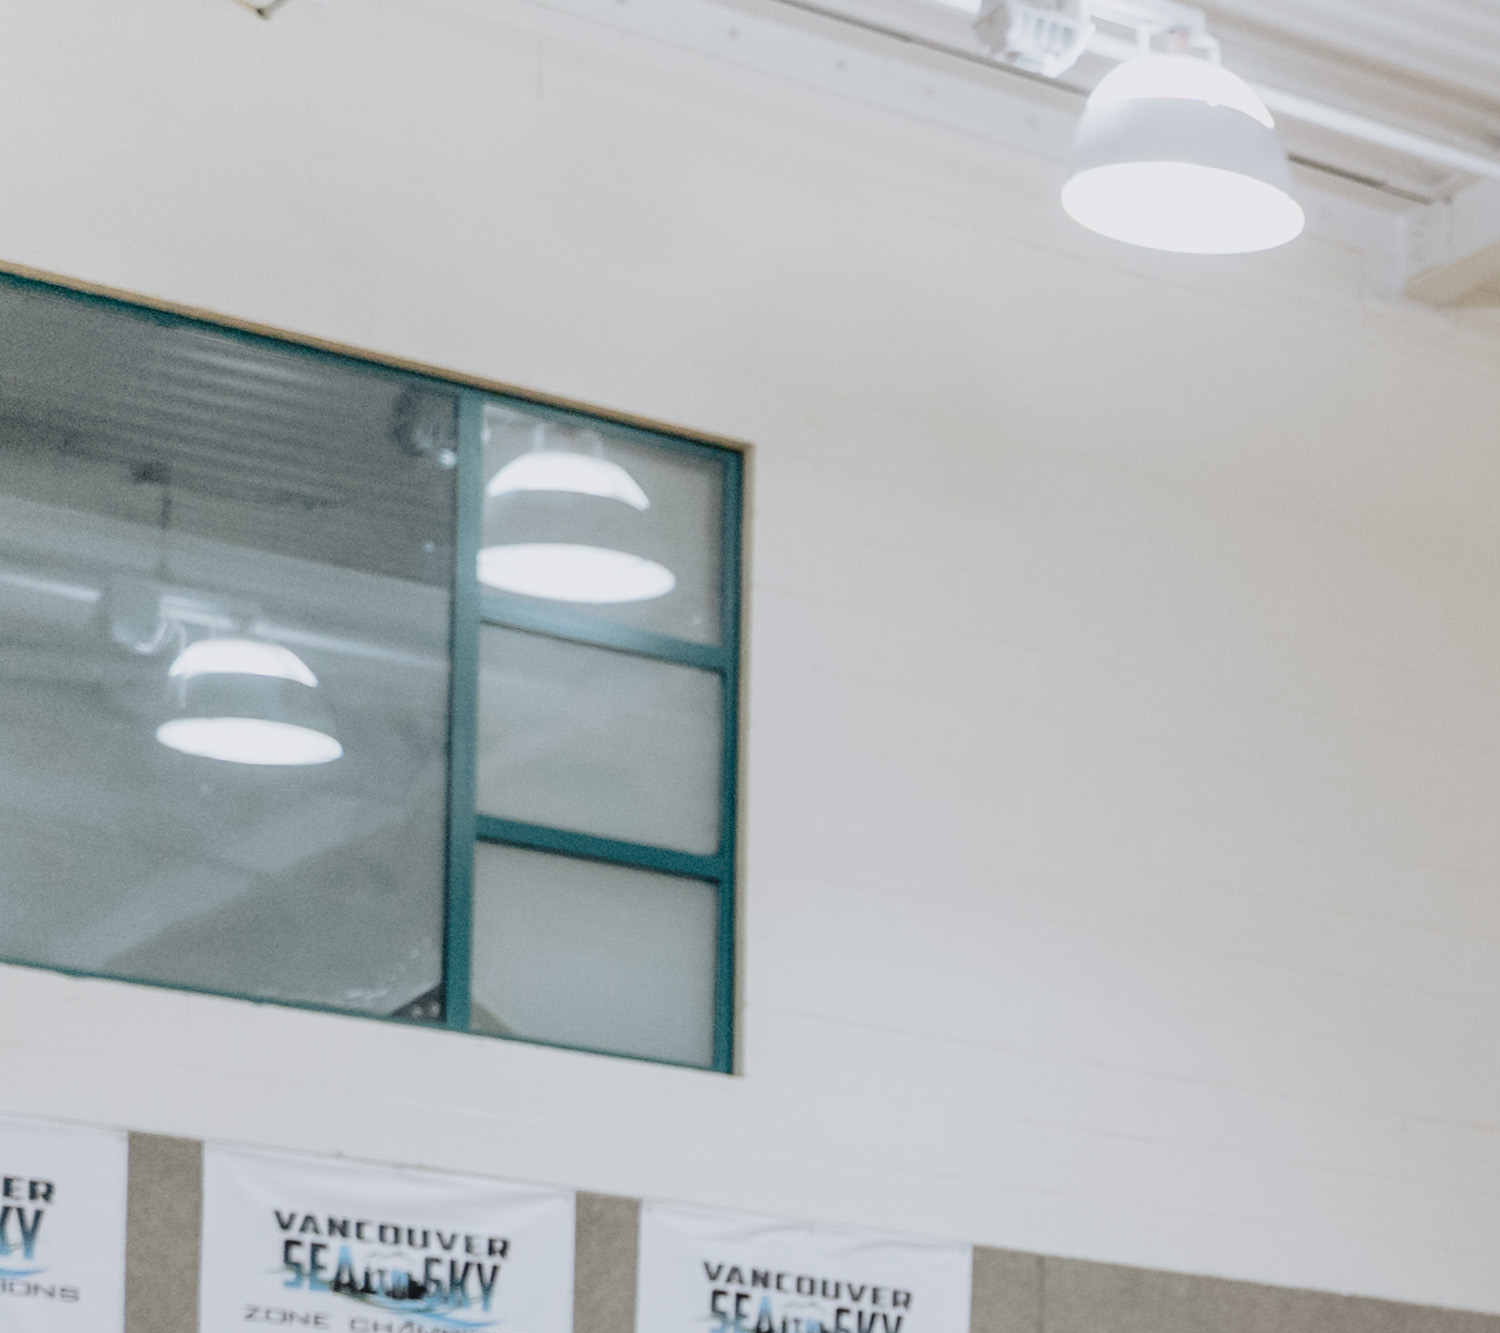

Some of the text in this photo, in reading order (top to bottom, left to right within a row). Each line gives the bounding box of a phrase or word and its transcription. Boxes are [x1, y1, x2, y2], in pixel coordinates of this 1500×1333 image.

[273, 1209, 510, 1259] VANCOUVER
[703, 1261, 912, 1311] VANCOUVER
[244, 1304, 331, 1331] ZONE
